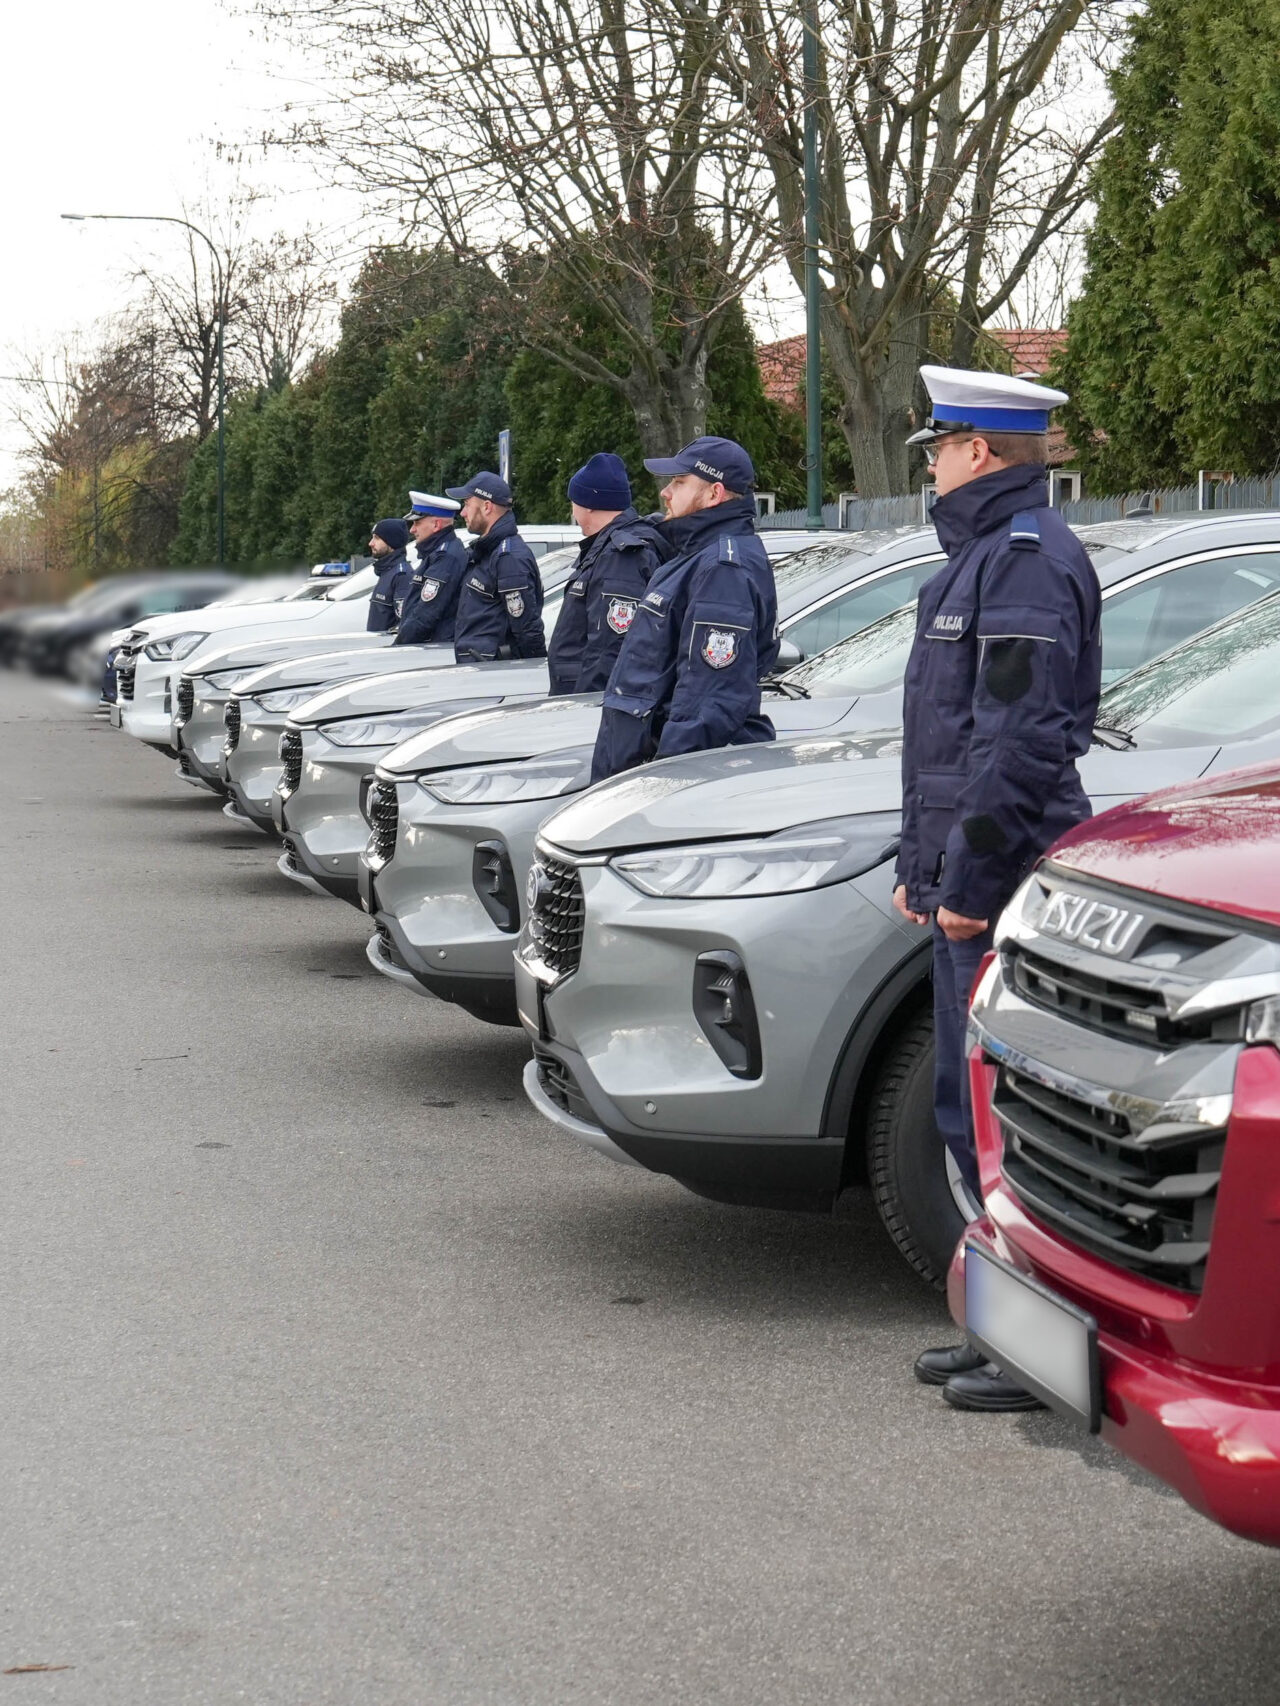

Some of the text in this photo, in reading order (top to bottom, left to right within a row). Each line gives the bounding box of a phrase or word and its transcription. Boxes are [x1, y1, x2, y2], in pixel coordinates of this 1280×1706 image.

[694, 460, 725, 481] POLICJA
[932, 615, 963, 631] POLICJA
[1041, 889, 1145, 956] ISUZU
